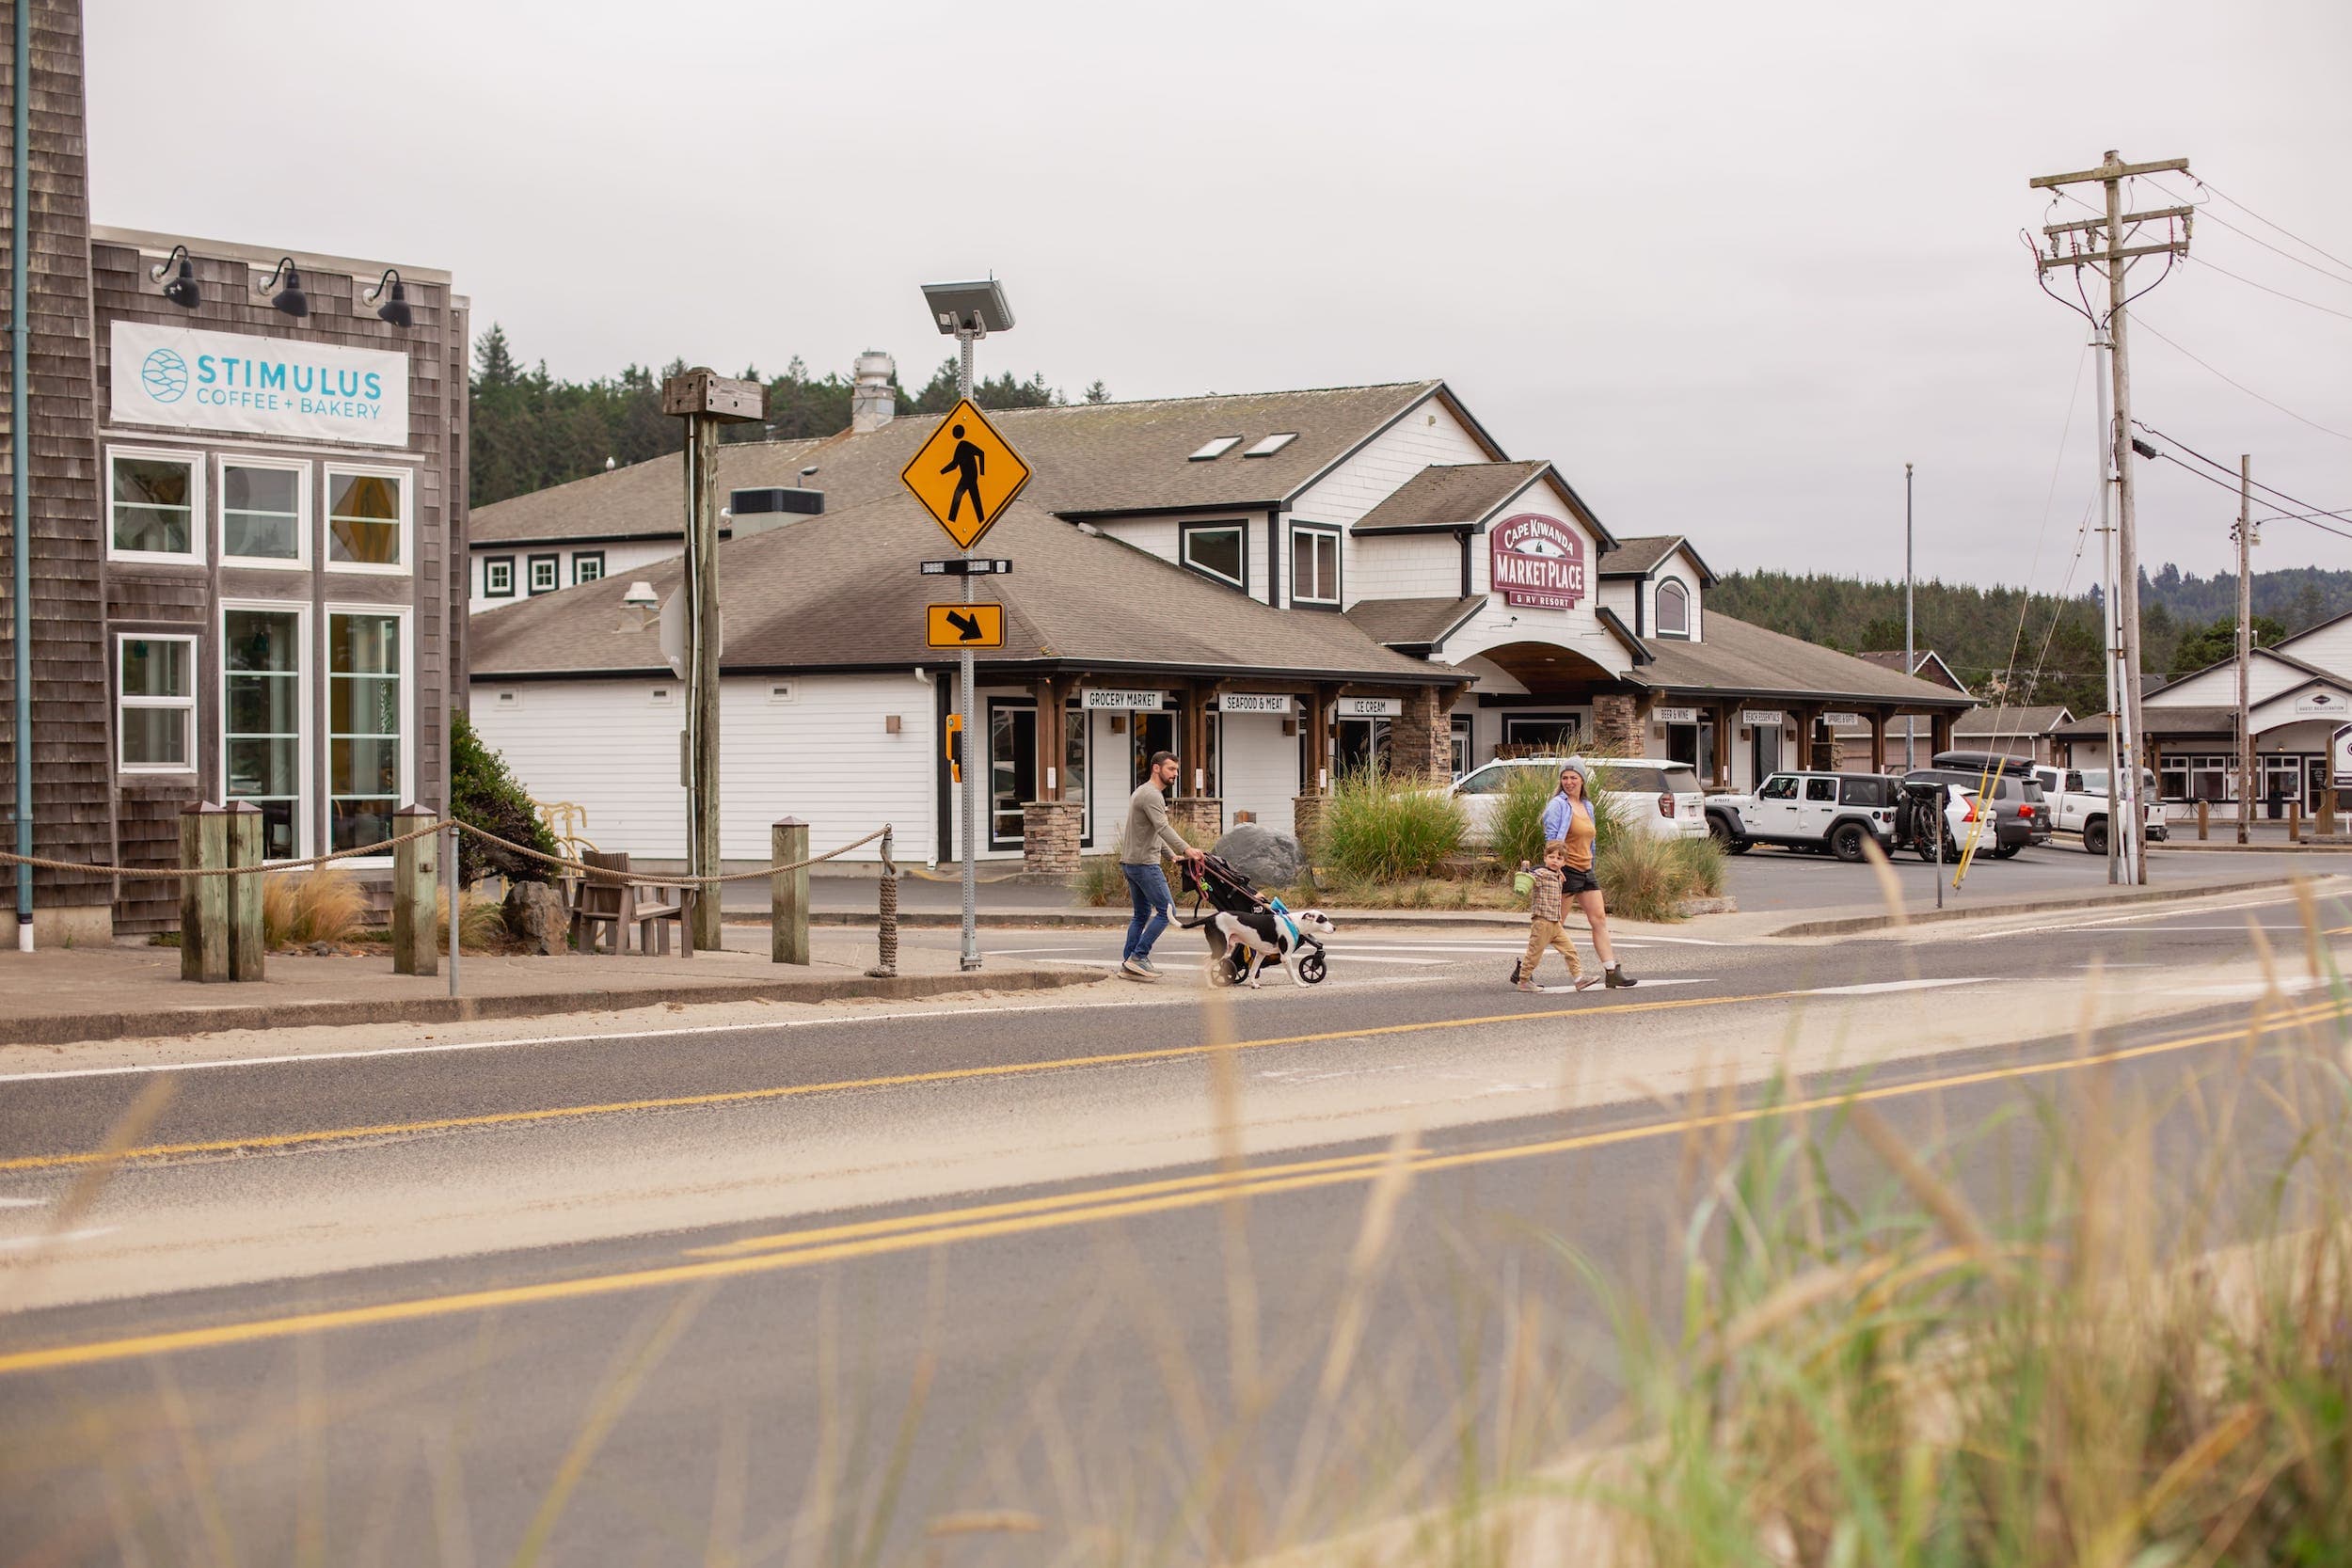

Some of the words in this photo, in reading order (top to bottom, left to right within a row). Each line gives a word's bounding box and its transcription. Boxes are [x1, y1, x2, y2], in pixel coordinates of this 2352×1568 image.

[197, 355, 381, 400] STIMULUS
[197, 388, 278, 410] COFFEE
[284, 399, 294, 409] +
[301, 398, 381, 420] BAKERY
[1504, 523, 1529, 548] CAPE
[1530, 519, 1573, 556] KIWANDA
[1526, 595, 1536, 604] RV
[1540, 597, 1568, 607] RESORT
[1089, 692, 1124, 705] GROCERY
[1127, 693, 1155, 706] MARKET
[1228, 697, 1257, 709] SEAFOOD
[1259, 697, 1264, 709] &
[1266, 698, 1282, 709] MEAT
[1355, 701, 1364, 712] ICE
[1366, 701, 1385, 712] CREAM
[1661, 709, 1672, 719] BEER
[1674, 709, 1677, 719] &
[1677, 710, 1689, 720] WINE
[1746, 712, 1758, 721] BEACH
[1759, 712, 1779, 721] ESSENTIALS
